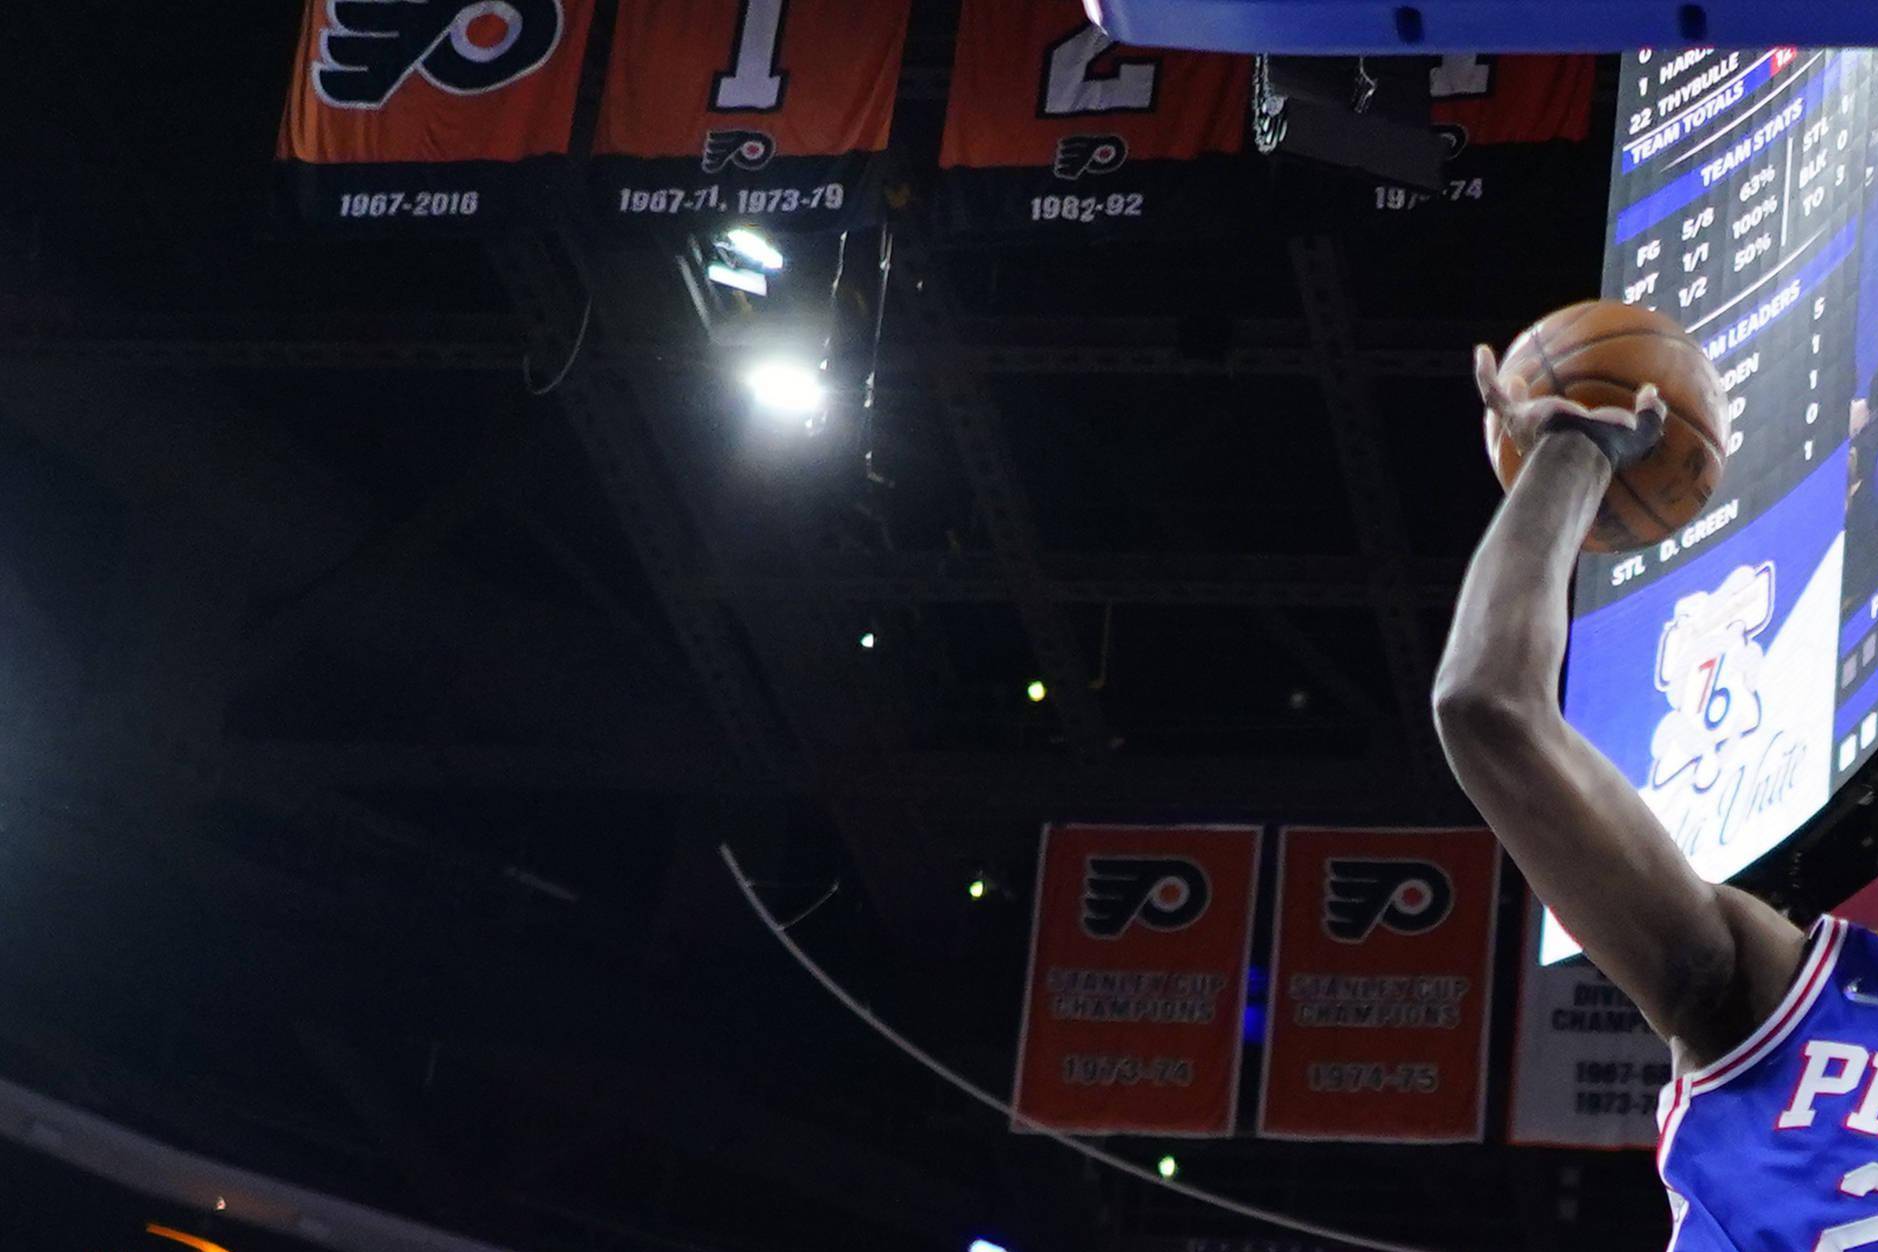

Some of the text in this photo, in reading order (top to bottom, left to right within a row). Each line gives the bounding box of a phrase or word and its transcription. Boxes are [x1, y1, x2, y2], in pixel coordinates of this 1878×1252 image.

[1629, 51, 1740, 135] 22 THYBULLE
[1630, 122, 1681, 164] TEAM
[1682, 79, 1745, 133] TOTALS
[1700, 137, 1752, 187] TEAM
[1753, 97, 1803, 151] STATS
[340, 191, 478, 218] 1967-2016
[1030, 192, 1143, 222] 1982-92
[1636, 239, 1661, 268] FG
[1739, 165, 1776, 202] 63%
[1682, 242, 1710, 272] 1/1
[1731, 194, 1778, 240] 100%
[1678, 231, 1772, 307] 1/2 50%
[1728, 278, 1801, 348] LEADERS
[1610, 560, 1646, 587] STL
[1681, 498, 1739, 550] GREEN
